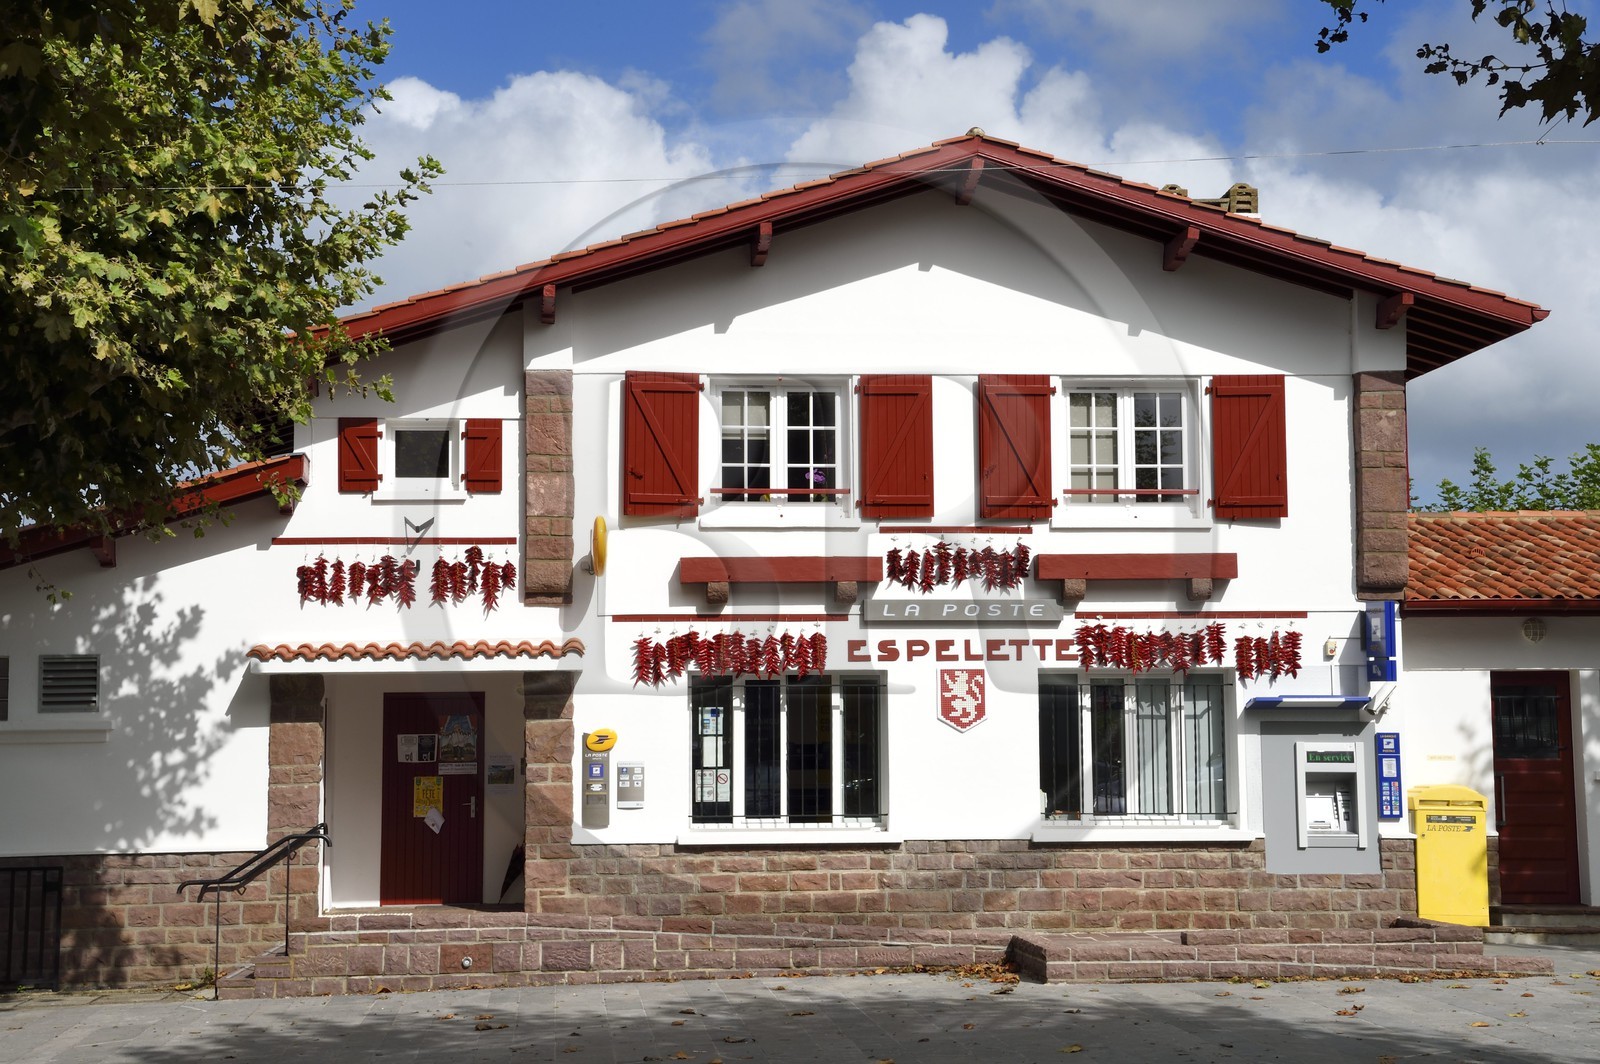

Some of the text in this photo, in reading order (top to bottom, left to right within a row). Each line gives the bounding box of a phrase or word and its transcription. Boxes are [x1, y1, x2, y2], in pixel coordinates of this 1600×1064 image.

[883, 604, 1046, 617] LA POSTE
[847, 639, 1079, 662] ESPELETTE
[1309, 753, 1352, 761] En service
